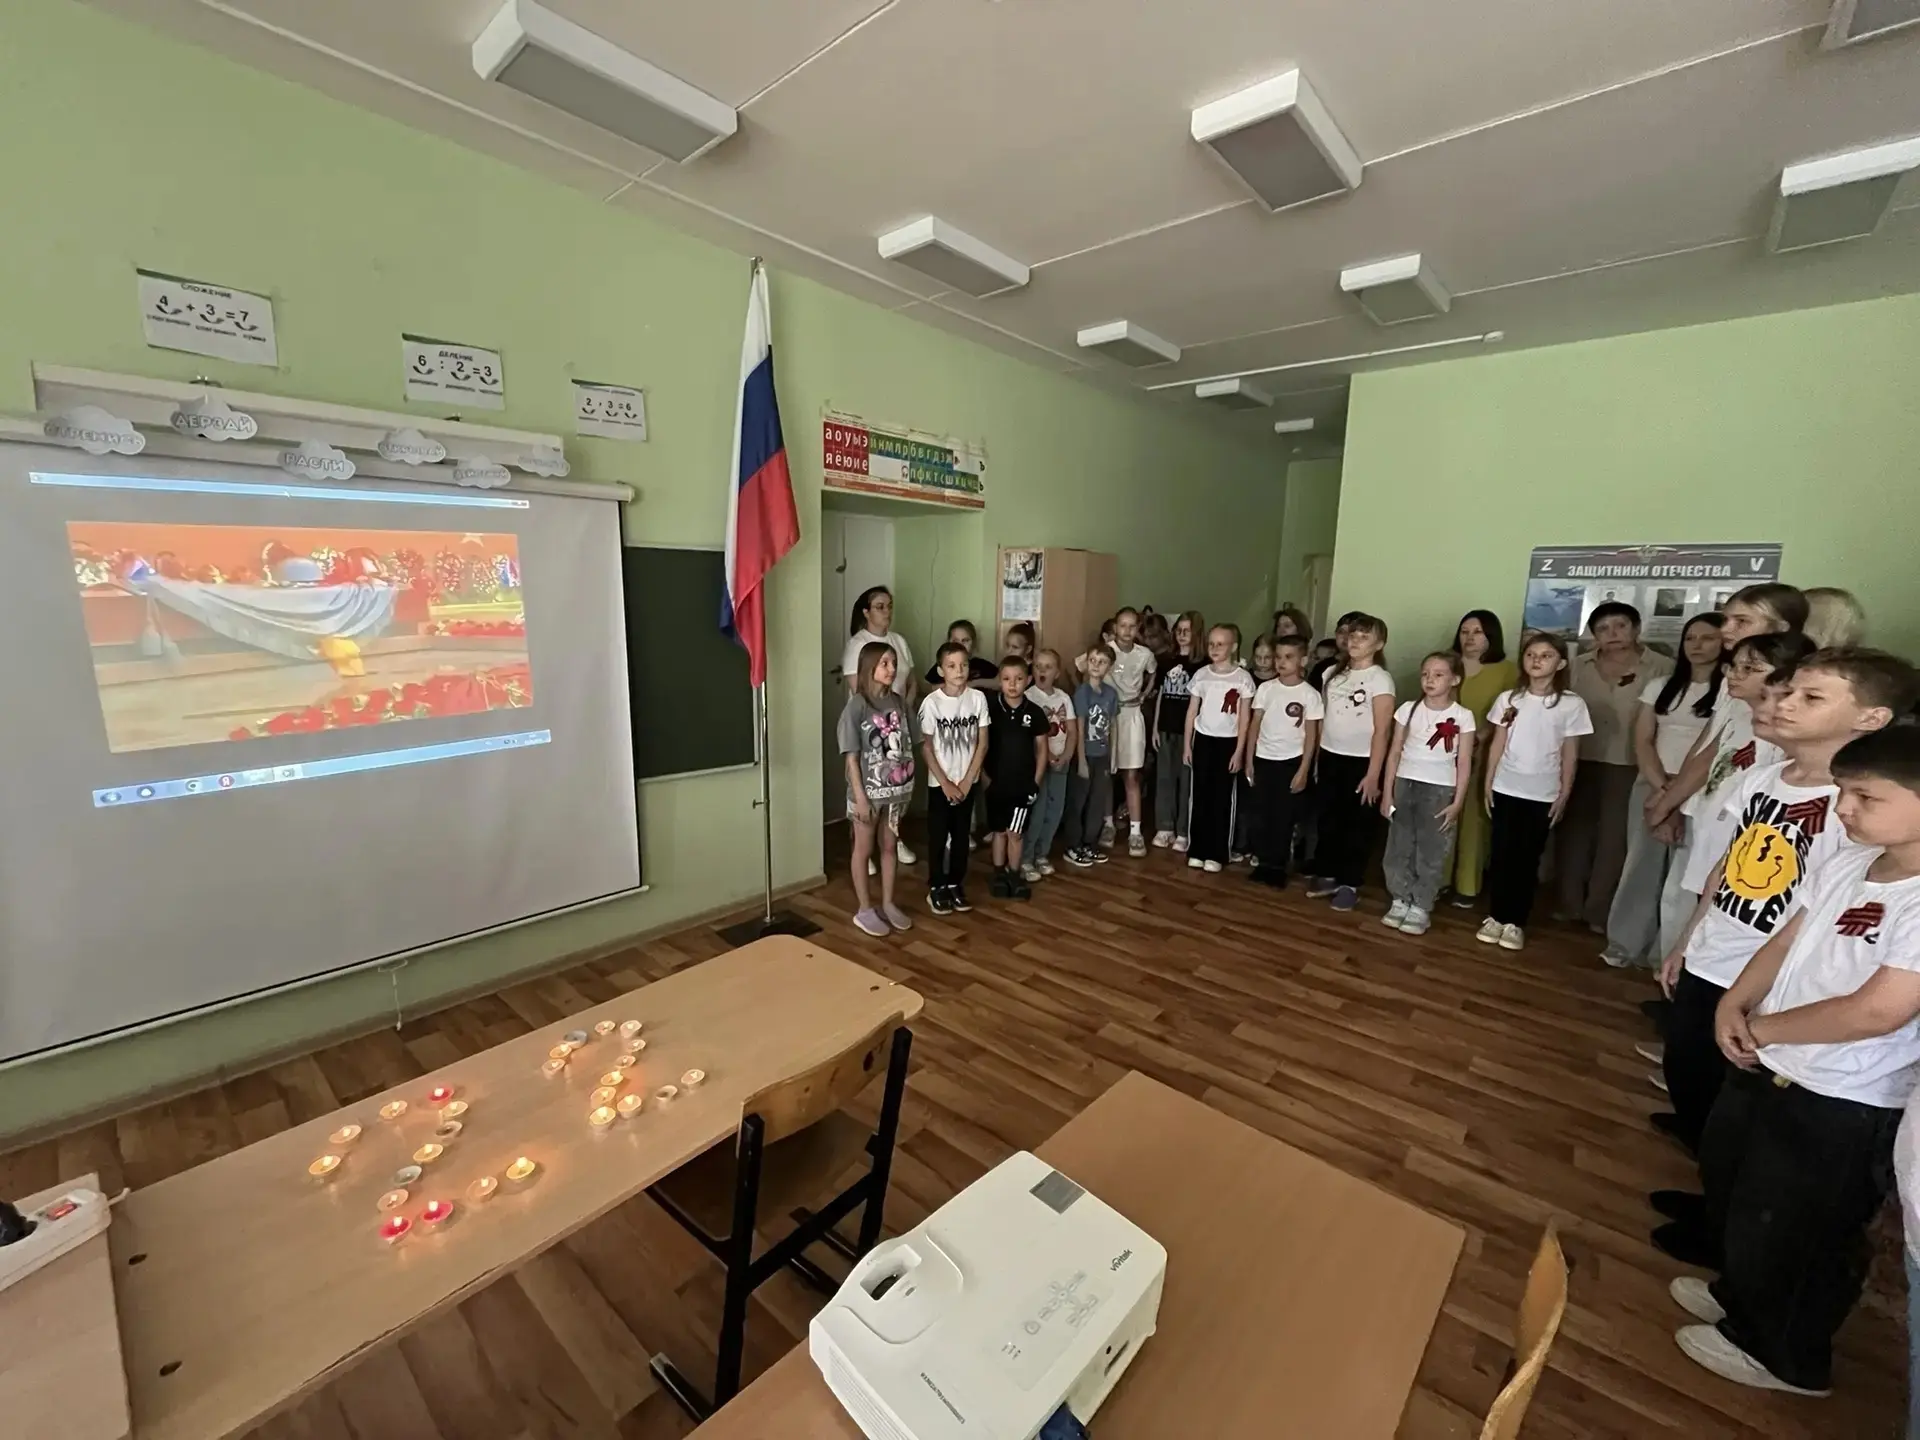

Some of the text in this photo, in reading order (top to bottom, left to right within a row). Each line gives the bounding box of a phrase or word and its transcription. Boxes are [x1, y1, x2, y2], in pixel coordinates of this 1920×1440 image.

[175, 413, 253, 433] ДЕРЗАЙ
[284, 452, 345, 473] РАСТИ
[1541, 558, 1554, 571] Z
[1566, 564, 1731, 578] ЗАЩИТНИКИ ОТЕЧЕСТВА
[1750, 557, 1765, 572] V
